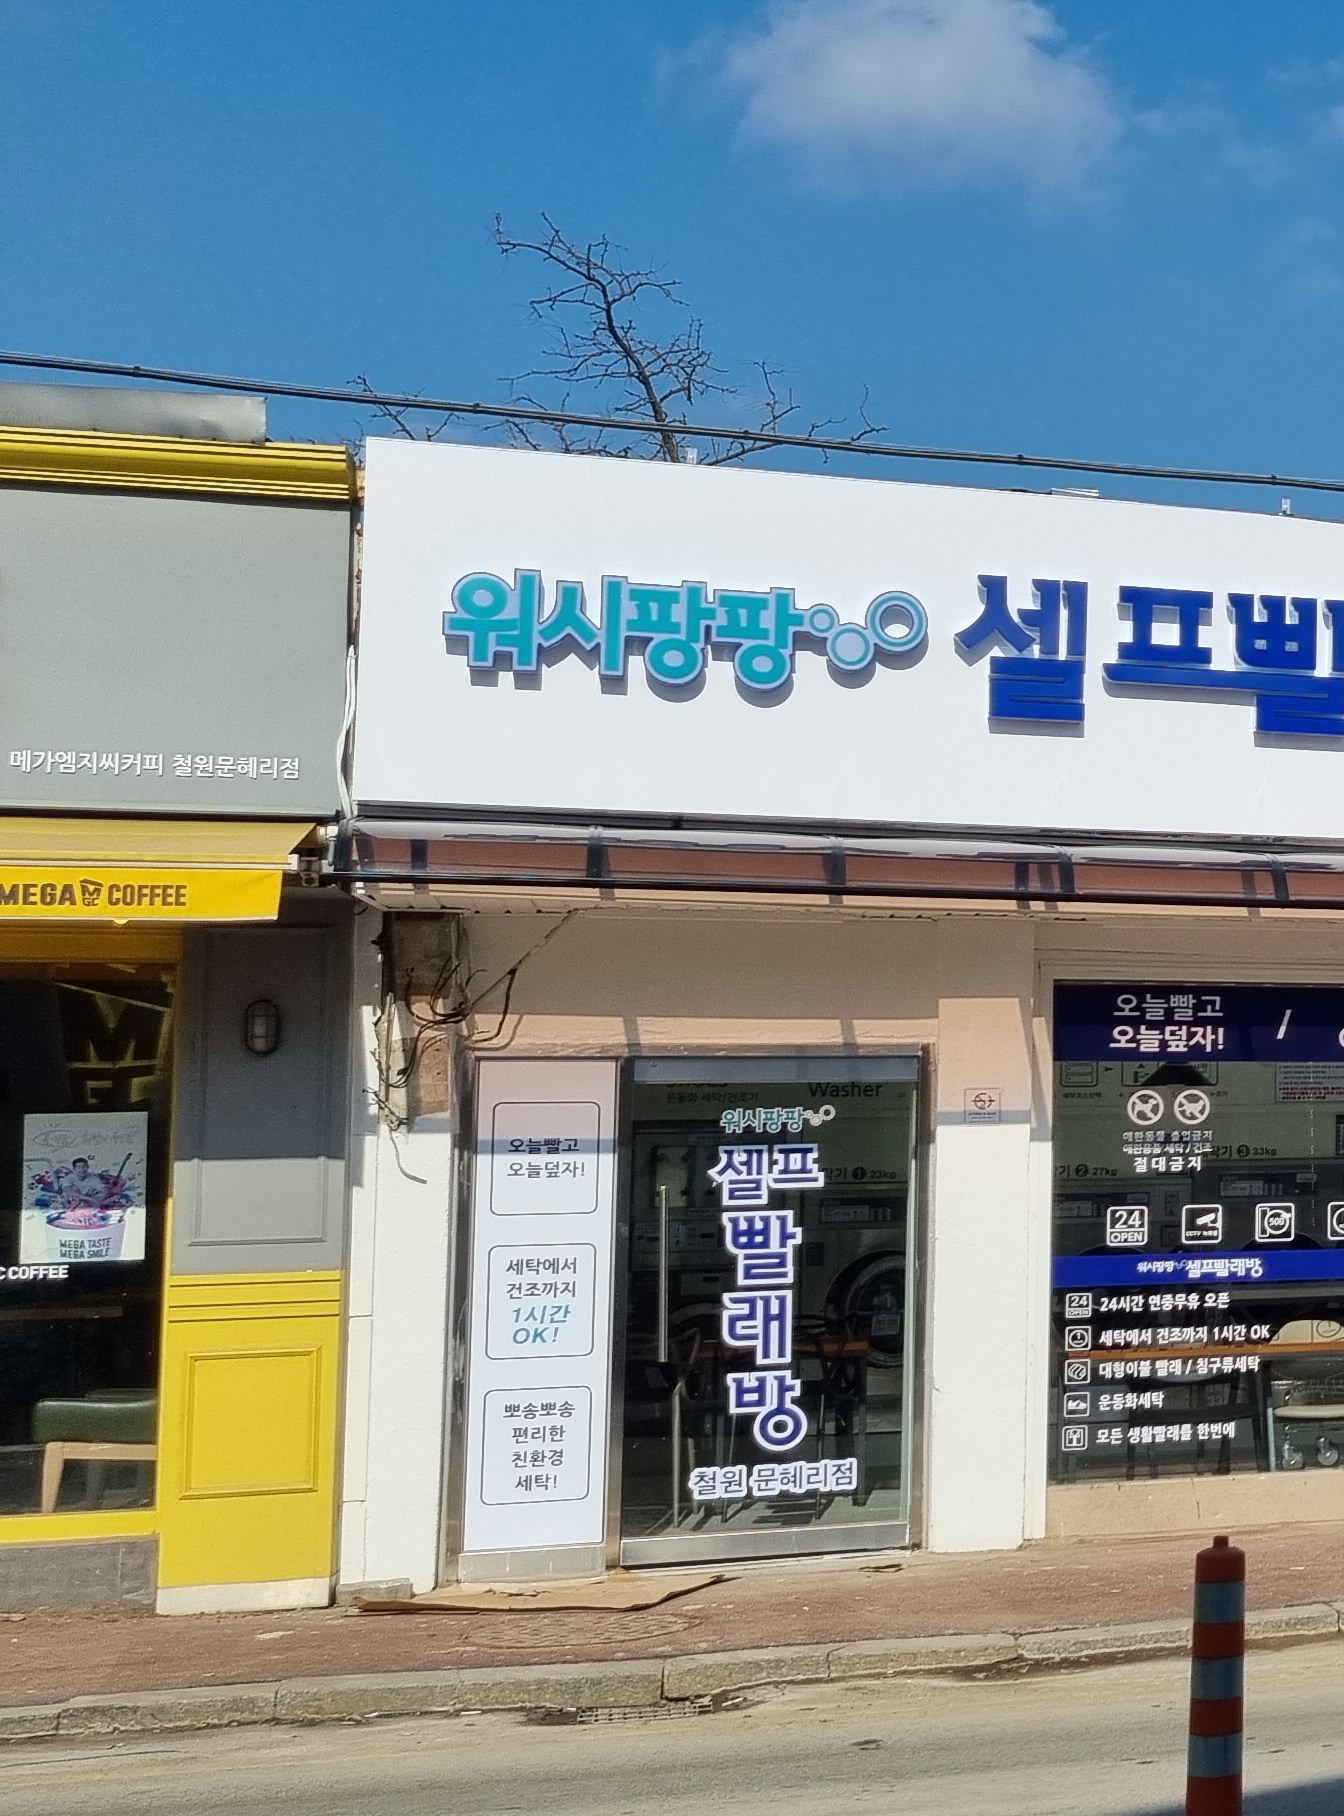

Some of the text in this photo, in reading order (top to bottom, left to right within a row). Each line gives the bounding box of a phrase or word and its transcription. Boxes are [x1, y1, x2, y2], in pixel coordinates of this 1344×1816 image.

[443, 568, 804, 690] 워시팡팡
[10, 750, 300, 779] 메가엠지씨커피 철원문혜리점
[0, 883, 187, 907] MEGA COFFEE
[1113, 994, 1224, 1021] 오늘빨고
[1109, 1026, 1225, 1052] 오늘덮자!
[808, 1082, 883, 1098] Washer
[721, 1107, 803, 1133] 워시팡팡
[507, 1138, 580, 1155] 오늘빨고
[506, 1161, 585, 1178] 오늘덮자!
[1114, 1210, 1142, 1229] 24
[59, 1237, 112, 1249] MEGA TASTE
[1111, 1232, 1143, 1242] OPEN
[60, 1248, 85, 1258] MEGA
[8, 1265, 69, 1279] COFFEE
[506, 1257, 578, 1275] 세탁에서
[1186, 1258, 1264, 1278] 셀프빨래방
[506, 1281, 577, 1299] 건조까지
[1070, 1296, 1088, 1307] 24
[1100, 1292, 1231, 1312] 24시간 연중무휴 오픈
[512, 1305, 571, 1324] 1시간
[512, 1327, 559, 1344] OK!
[1099, 1324, 1270, 1346] 세탁에서 건조까지 1시간 OK
[1099, 1360, 1152, 1379] 대형이불
[1155, 1359, 1182, 1376] 빨래
[1196, 1356, 1261, 1374] 침구류세탁
[503, 1400, 575, 1420] 뽀송뽀송
[1098, 1391, 1165, 1410] 운동화세탁
[512, 1425, 566, 1444] 편리한
[1096, 1422, 1236, 1444] 모든 생활빨래를 한번에
[511, 1449, 564, 1468] 친환경
[515, 1474, 558, 1492] 세탁!
[692, 1460, 857, 1497] 철원 문혜리점
